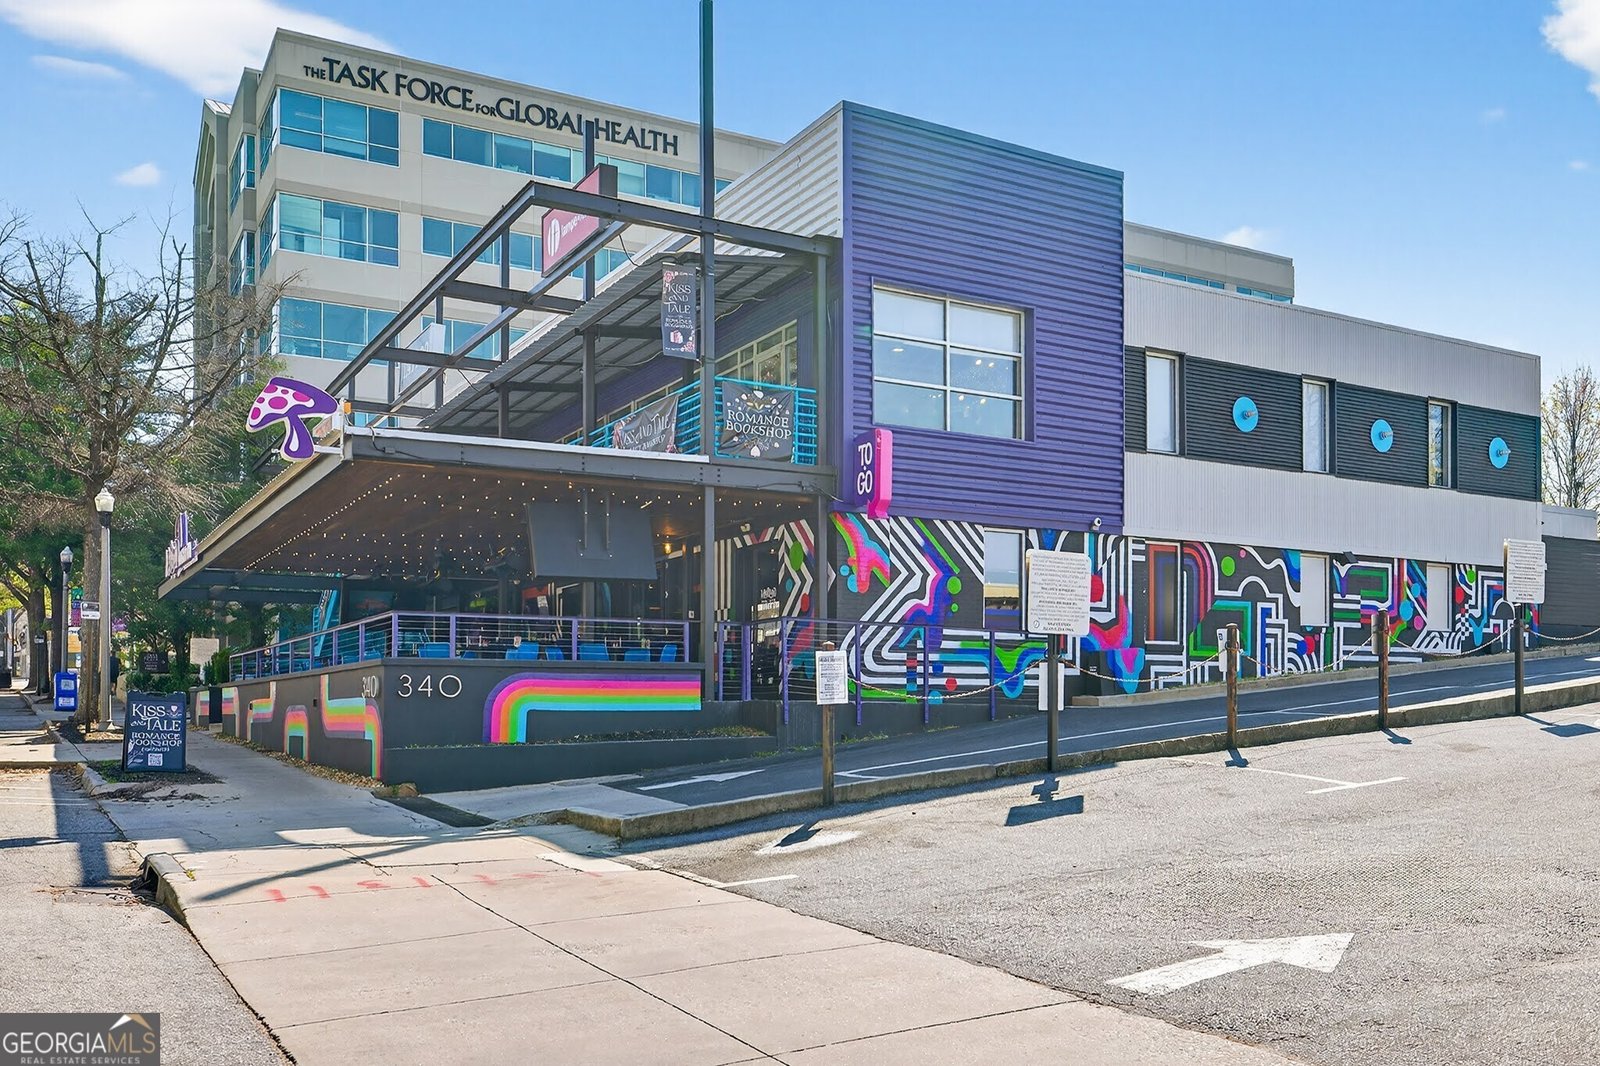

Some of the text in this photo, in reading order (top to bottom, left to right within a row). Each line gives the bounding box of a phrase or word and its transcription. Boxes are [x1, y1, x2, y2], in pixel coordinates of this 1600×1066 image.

[303, 56, 679, 156] THE TASK FORCE FOR GLOBAL HEALTH
[667, 283, 692, 295] KISS
[663, 301, 691, 314] TALE
[727, 409, 789, 428] ROMANCE
[726, 419, 792, 440] BOOKSHOP
[858, 442, 873, 467] TO
[857, 469, 873, 495] GO
[361, 675, 378, 699] 340
[397, 674, 463, 698] 340
[132, 703, 166, 718] KISS
[144, 716, 182, 731] TALE
[131, 732, 181, 740] ROMANCE
